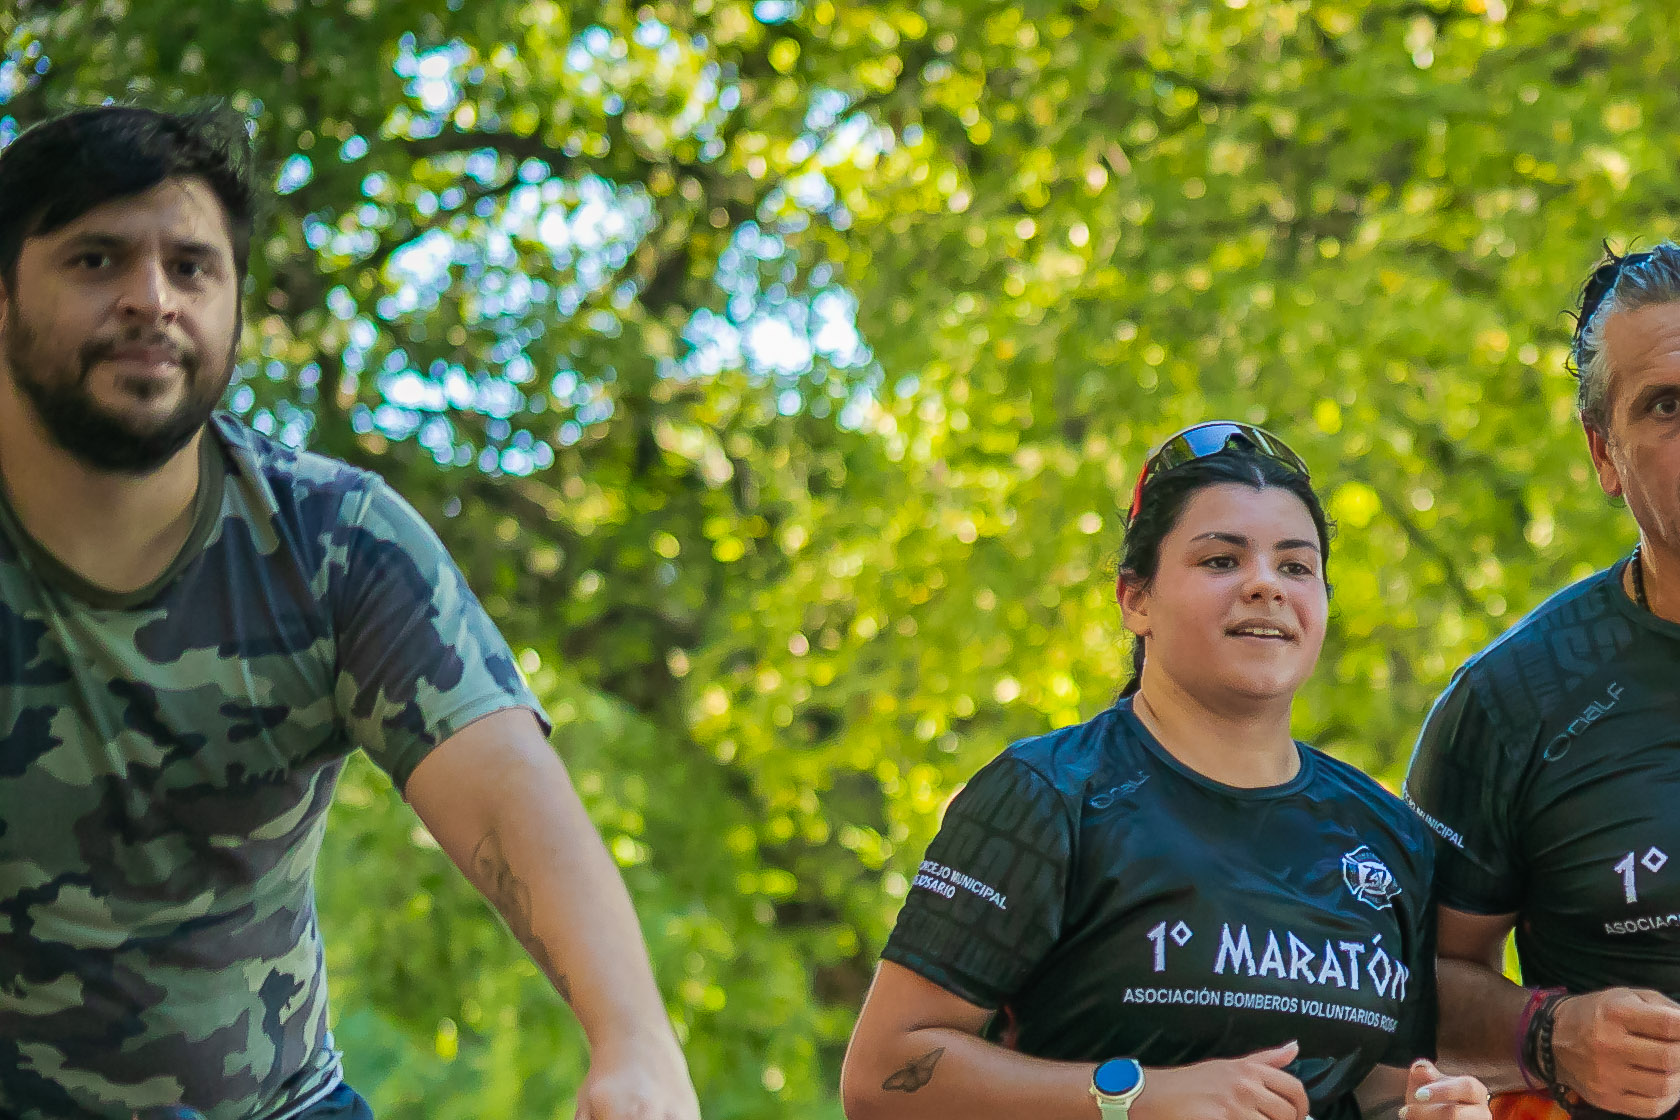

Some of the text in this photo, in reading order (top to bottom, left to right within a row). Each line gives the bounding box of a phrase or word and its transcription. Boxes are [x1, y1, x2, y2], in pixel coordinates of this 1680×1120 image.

[950, 869, 1007, 910] MUNICIPAL
[1213, 922, 1409, 1003] MARATÓN
[1122, 986, 1221, 1006] ASOCIACIÓN
[1223, 990, 1299, 1013] BOMBEROS
[1300, 999, 1381, 1028] VOLUNTARIOS
